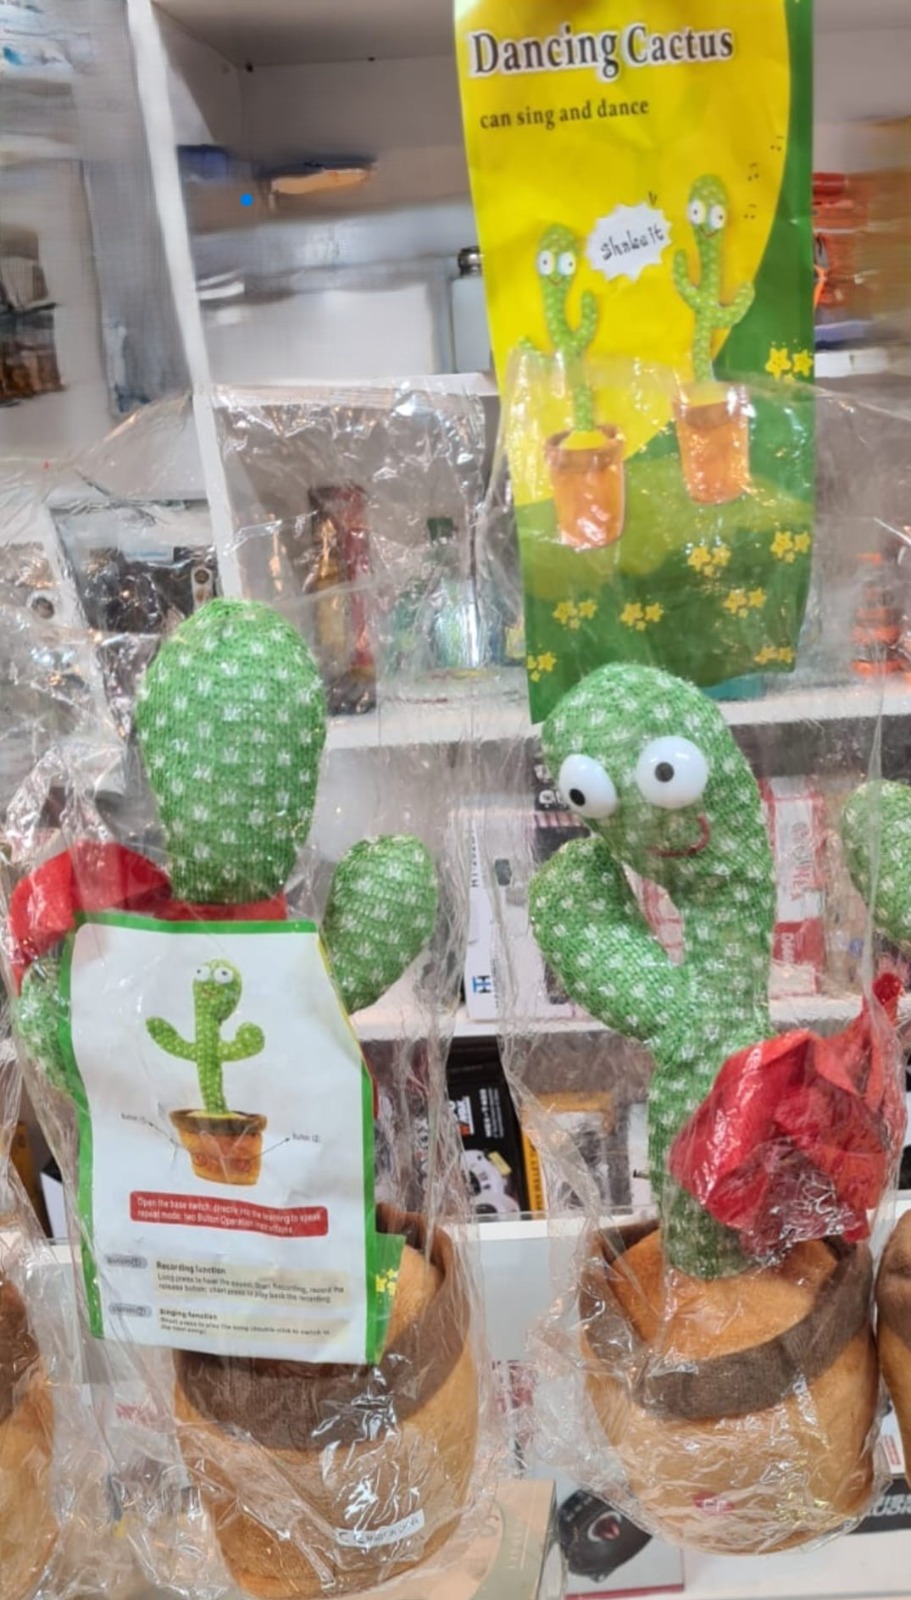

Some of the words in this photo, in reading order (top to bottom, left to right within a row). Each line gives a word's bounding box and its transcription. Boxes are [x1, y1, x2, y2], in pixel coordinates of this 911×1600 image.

[471, 25, 619, 79] Dancing
[626, 24, 735, 63] Cactus
[480, 112, 512, 129] can
[516, 104, 555, 131] sing
[559, 101, 592, 122] and
[597, 98, 650, 118] dance
[648, 223, 665, 245] it
[137, 1197, 157, 1208] Open
[158, 1199, 168, 1208] the
[170, 1200, 187, 1209] base
[137, 1210, 161, 1220] repeat
[156, 1260, 194, 1274] Recording
[195, 1264, 227, 1275] function
[158, 1272, 175, 1283] Long
[188, 1311, 218, 1320] function
